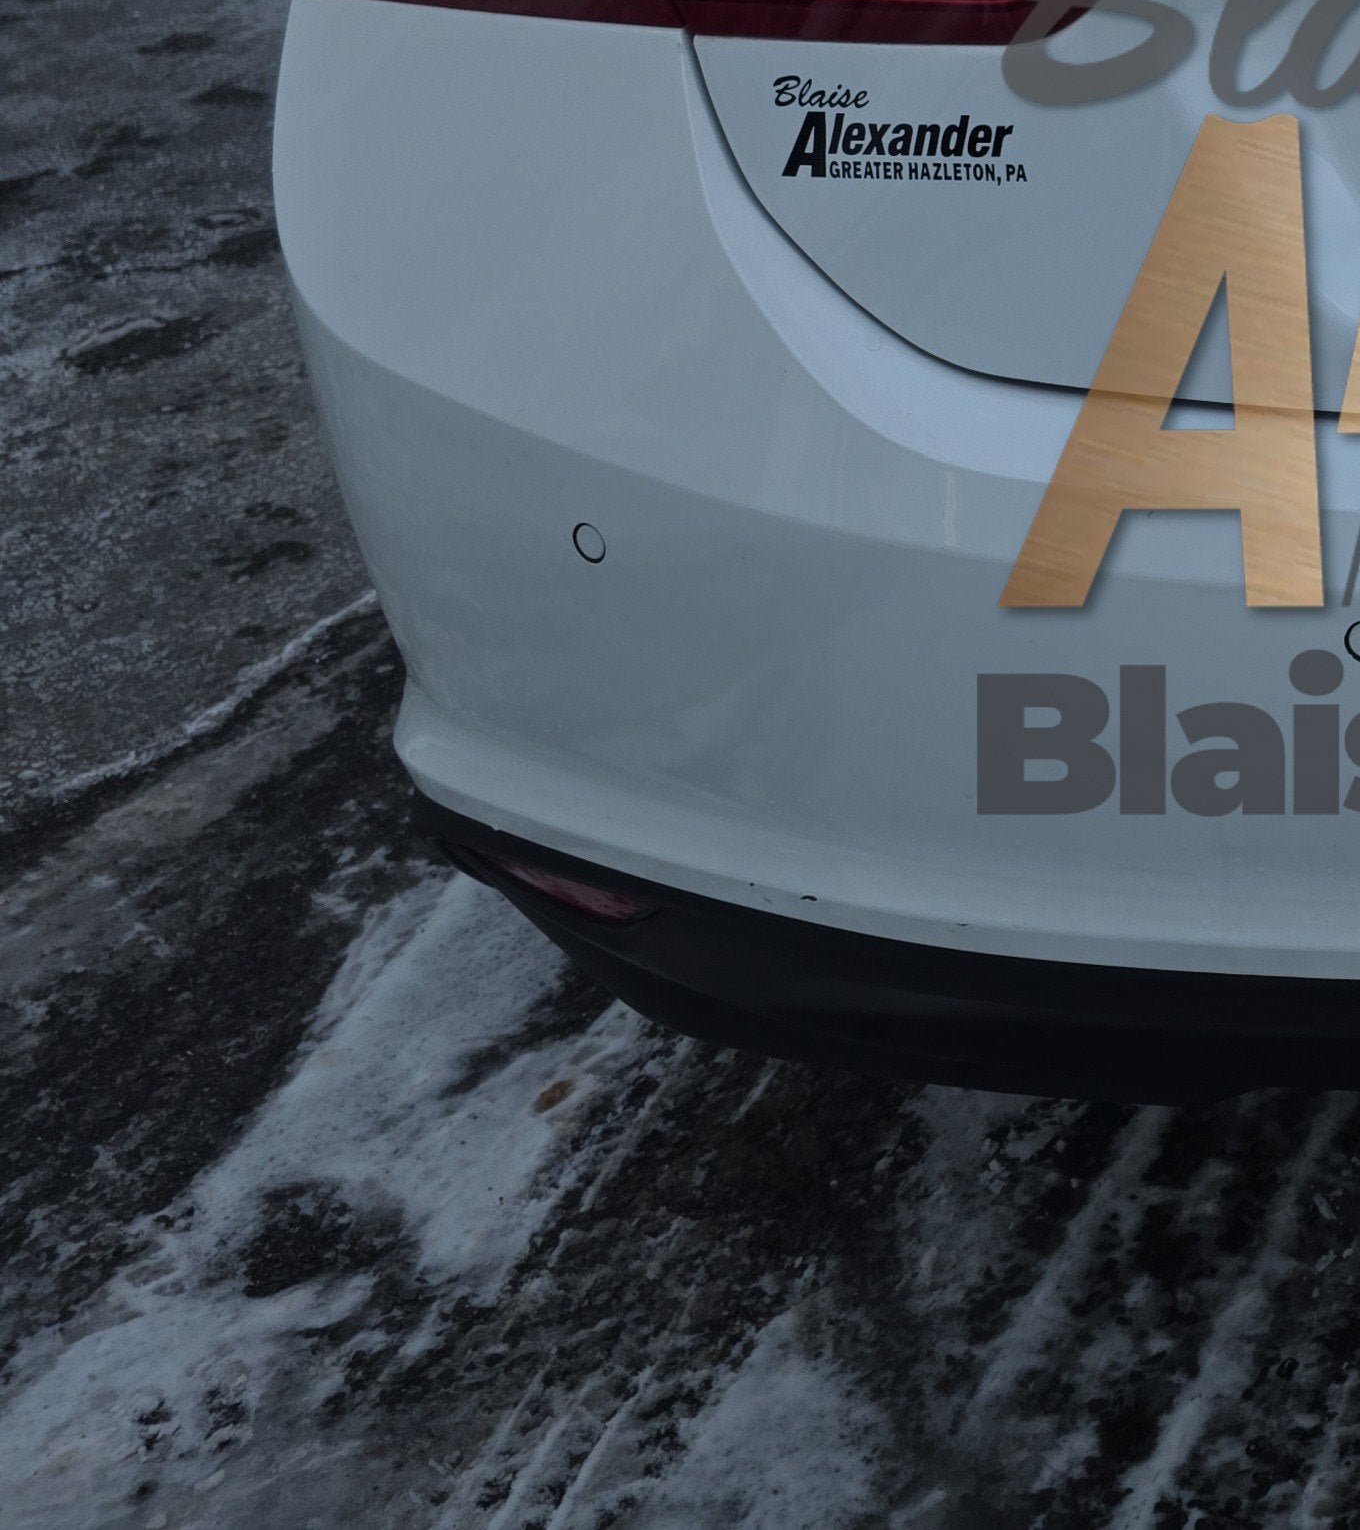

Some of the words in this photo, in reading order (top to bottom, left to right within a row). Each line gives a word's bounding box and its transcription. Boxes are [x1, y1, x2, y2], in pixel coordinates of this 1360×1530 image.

[773, 75, 870, 109] Blaise
[781, 111, 1014, 178] Alexander
[829, 160, 903, 180] GREATER
[908, 162, 1001, 186] HAZLETON,
[1006, 163, 1028, 182] PA
